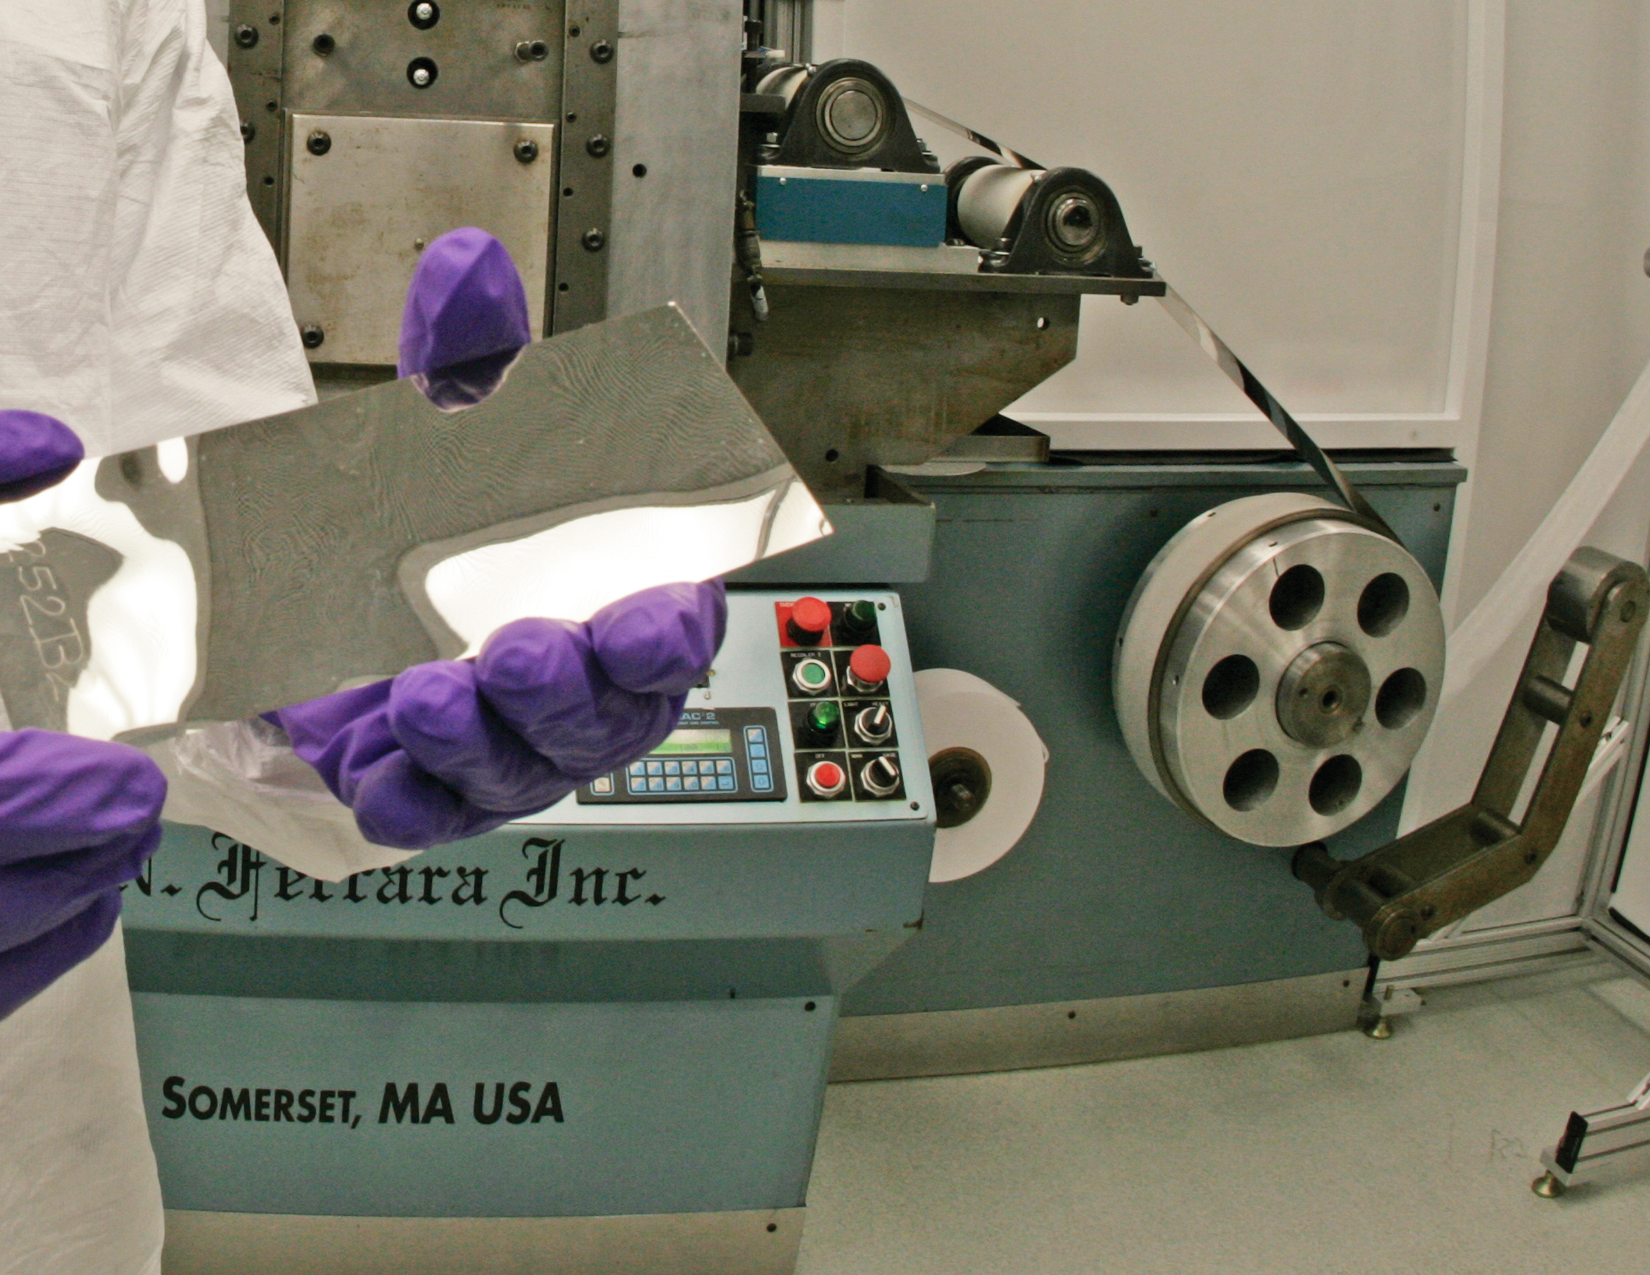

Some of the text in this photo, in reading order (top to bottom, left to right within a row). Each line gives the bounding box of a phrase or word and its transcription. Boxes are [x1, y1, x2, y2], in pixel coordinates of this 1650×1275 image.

[196, 831, 489, 921] Ferrara
[499, 837, 667, 929] Inc.
[161, 1075, 565, 1129] SOMERSET, MA USA
